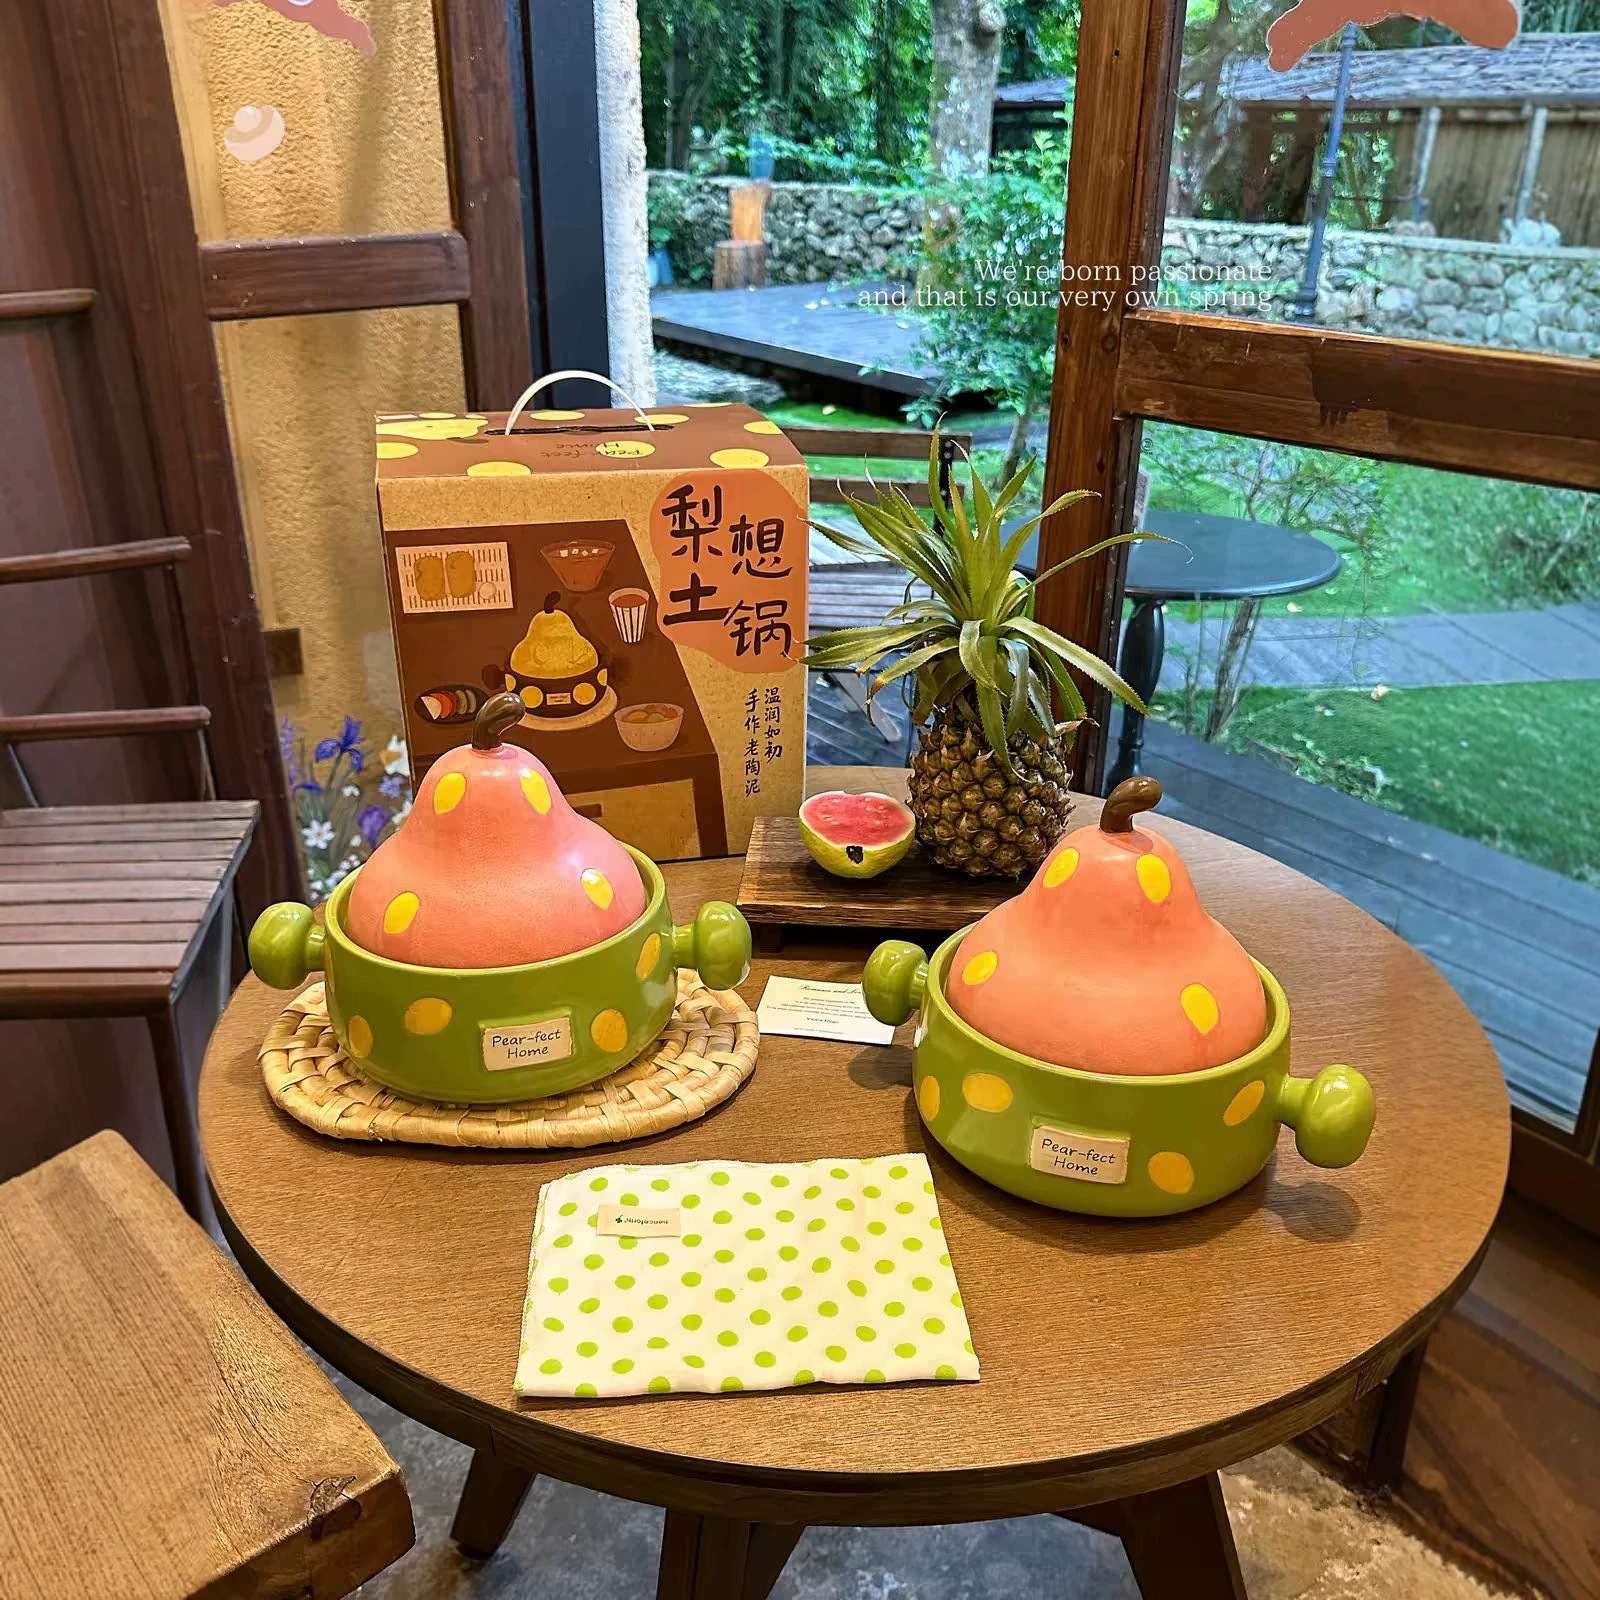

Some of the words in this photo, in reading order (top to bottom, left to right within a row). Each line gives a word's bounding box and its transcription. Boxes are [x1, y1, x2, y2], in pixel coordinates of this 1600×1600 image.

[764, 687, 783, 764] 温润如初
[744, 688, 761, 798] 手作老陶泥
[492, 1029, 561, 1047] Pear-fect
[507, 1046, 548, 1059] Home
[1041, 1138, 1116, 1164] Pear-fect
[1053, 1156, 1098, 1175] Home
